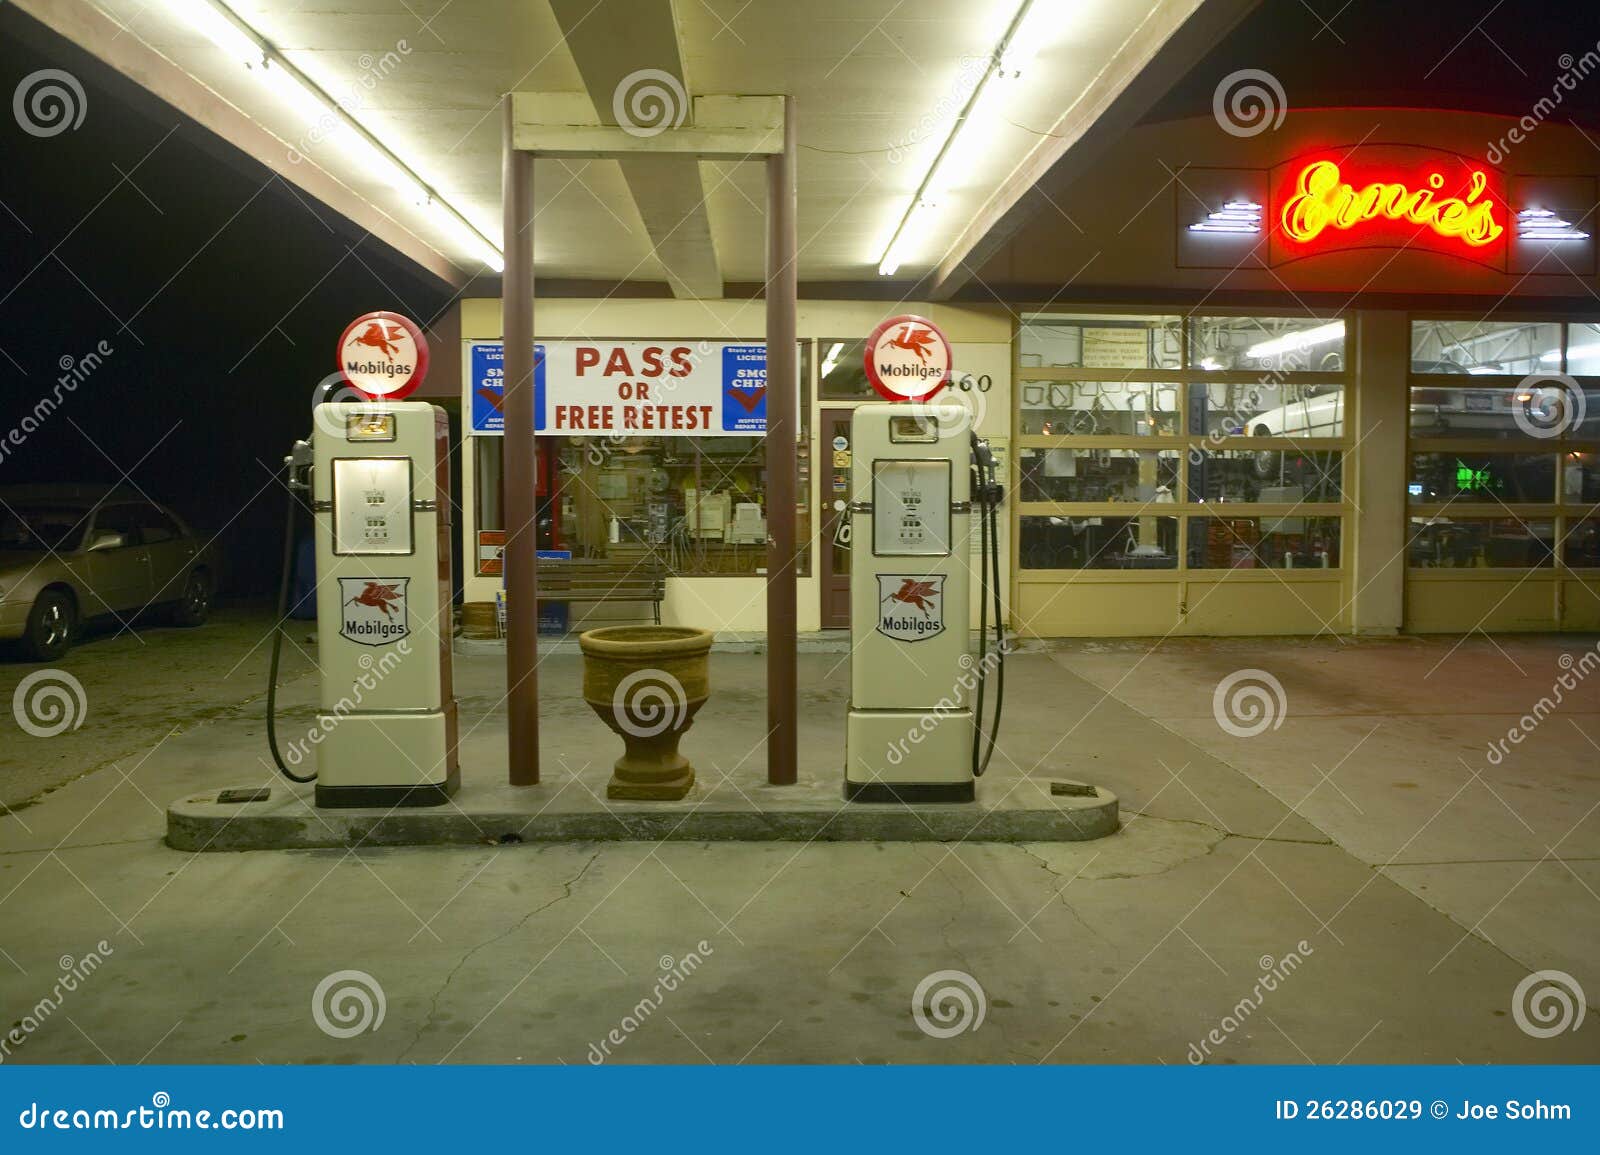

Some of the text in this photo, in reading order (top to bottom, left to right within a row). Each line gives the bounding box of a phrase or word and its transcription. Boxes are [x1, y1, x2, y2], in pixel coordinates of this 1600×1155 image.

[1282, 161, 1503, 246] Ernie's
[347, 361, 411, 379] Mobilgas
[575, 346, 693, 378] PASS
[880, 363, 942, 381] Mobilgas
[618, 382, 650, 400] OR
[555, 405, 713, 429] FREE RETEST
[345, 620, 405, 638] Mobilgas
[882, 617, 940, 634] Mobilgas
